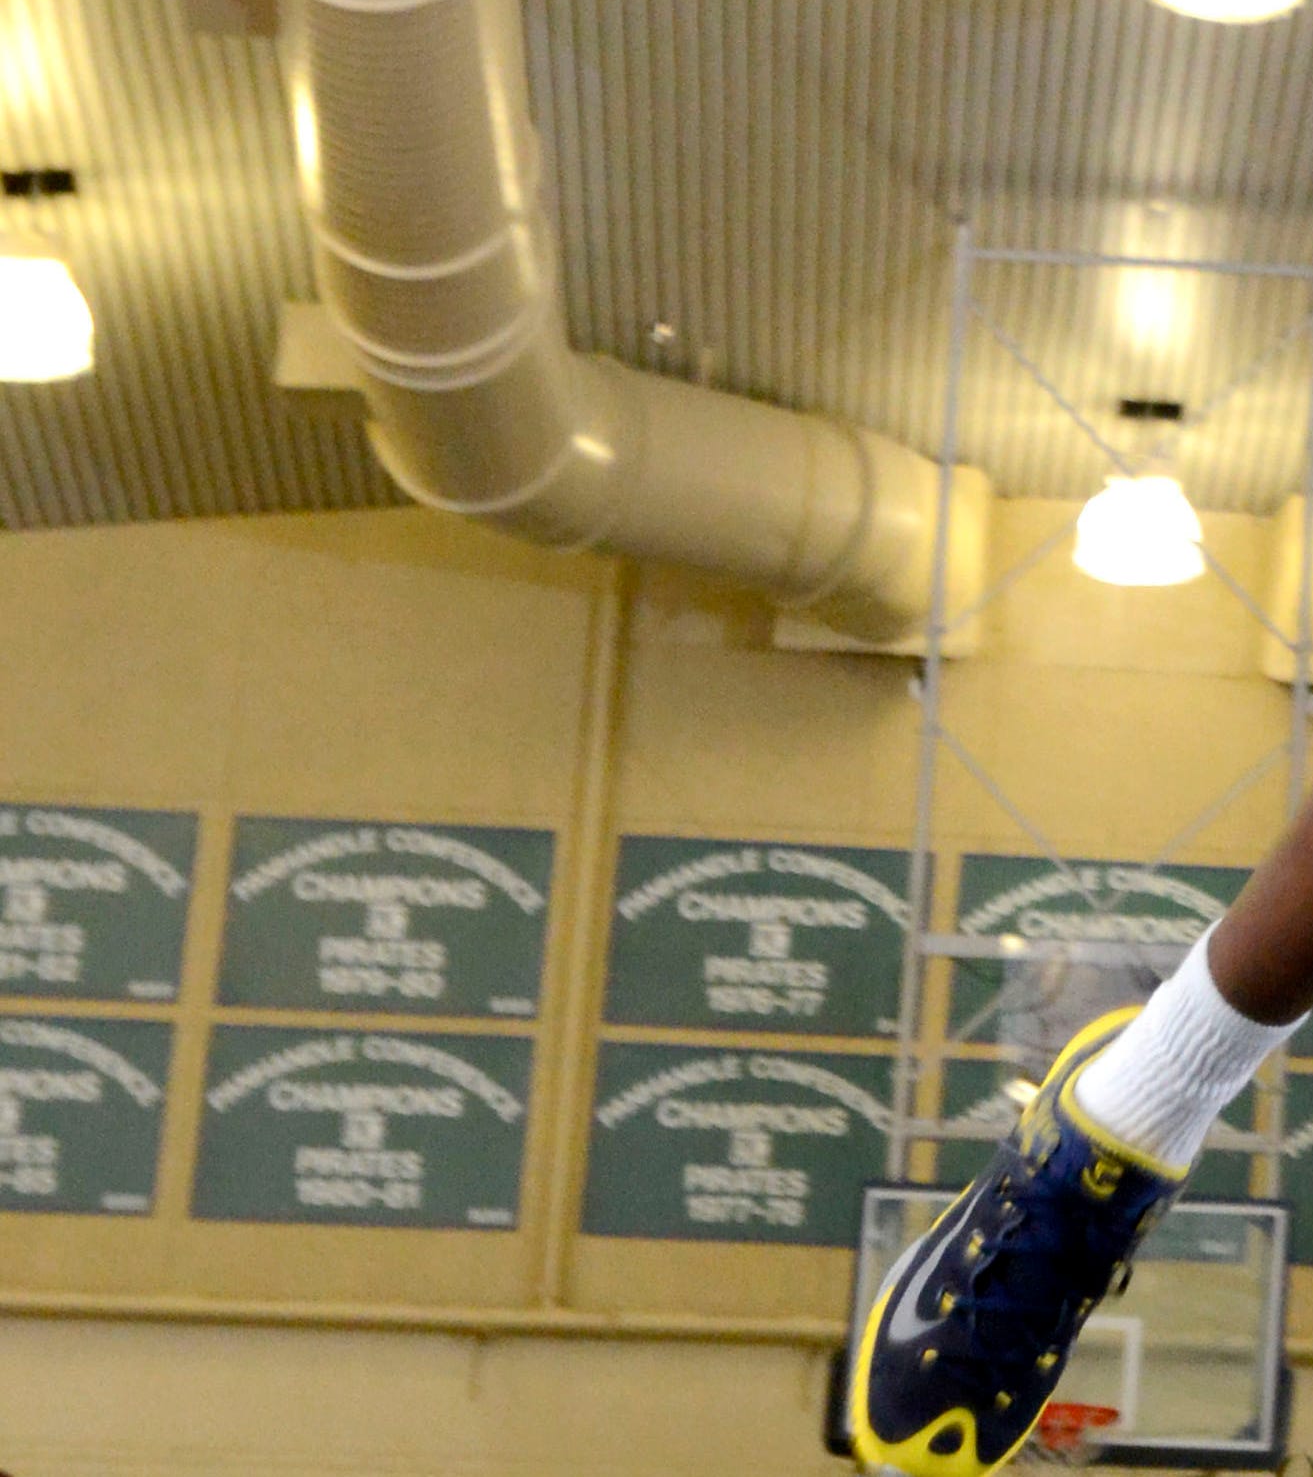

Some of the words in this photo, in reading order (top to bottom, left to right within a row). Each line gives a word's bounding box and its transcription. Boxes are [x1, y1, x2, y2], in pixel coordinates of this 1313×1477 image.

[231, 827, 378, 903] PANHANDLE
[385, 827, 545, 916] CONFERENCE
[617, 849, 761, 921] PANHANDLE
[293, 872, 487, 910] CHAMPIONS
[677, 890, 867, 929] CHAMPIONS
[1018, 908, 1212, 945] CHAMPIONS
[318, 935, 448, 968] PIRATES
[704, 955, 828, 988] PIRATES
[207, 1036, 355, 1113] PANHANDLE
[361, 1036, 524, 1123] CONFERENCE
[597, 1054, 742, 1128] PANHANDLE
[266, 1081, 464, 1119] CHAMPIONS
[656, 1096, 848, 1136] CHAMPIONS
[294, 1146, 423, 1179] PIRATES
[683, 1162, 808, 1197] PIRATES
